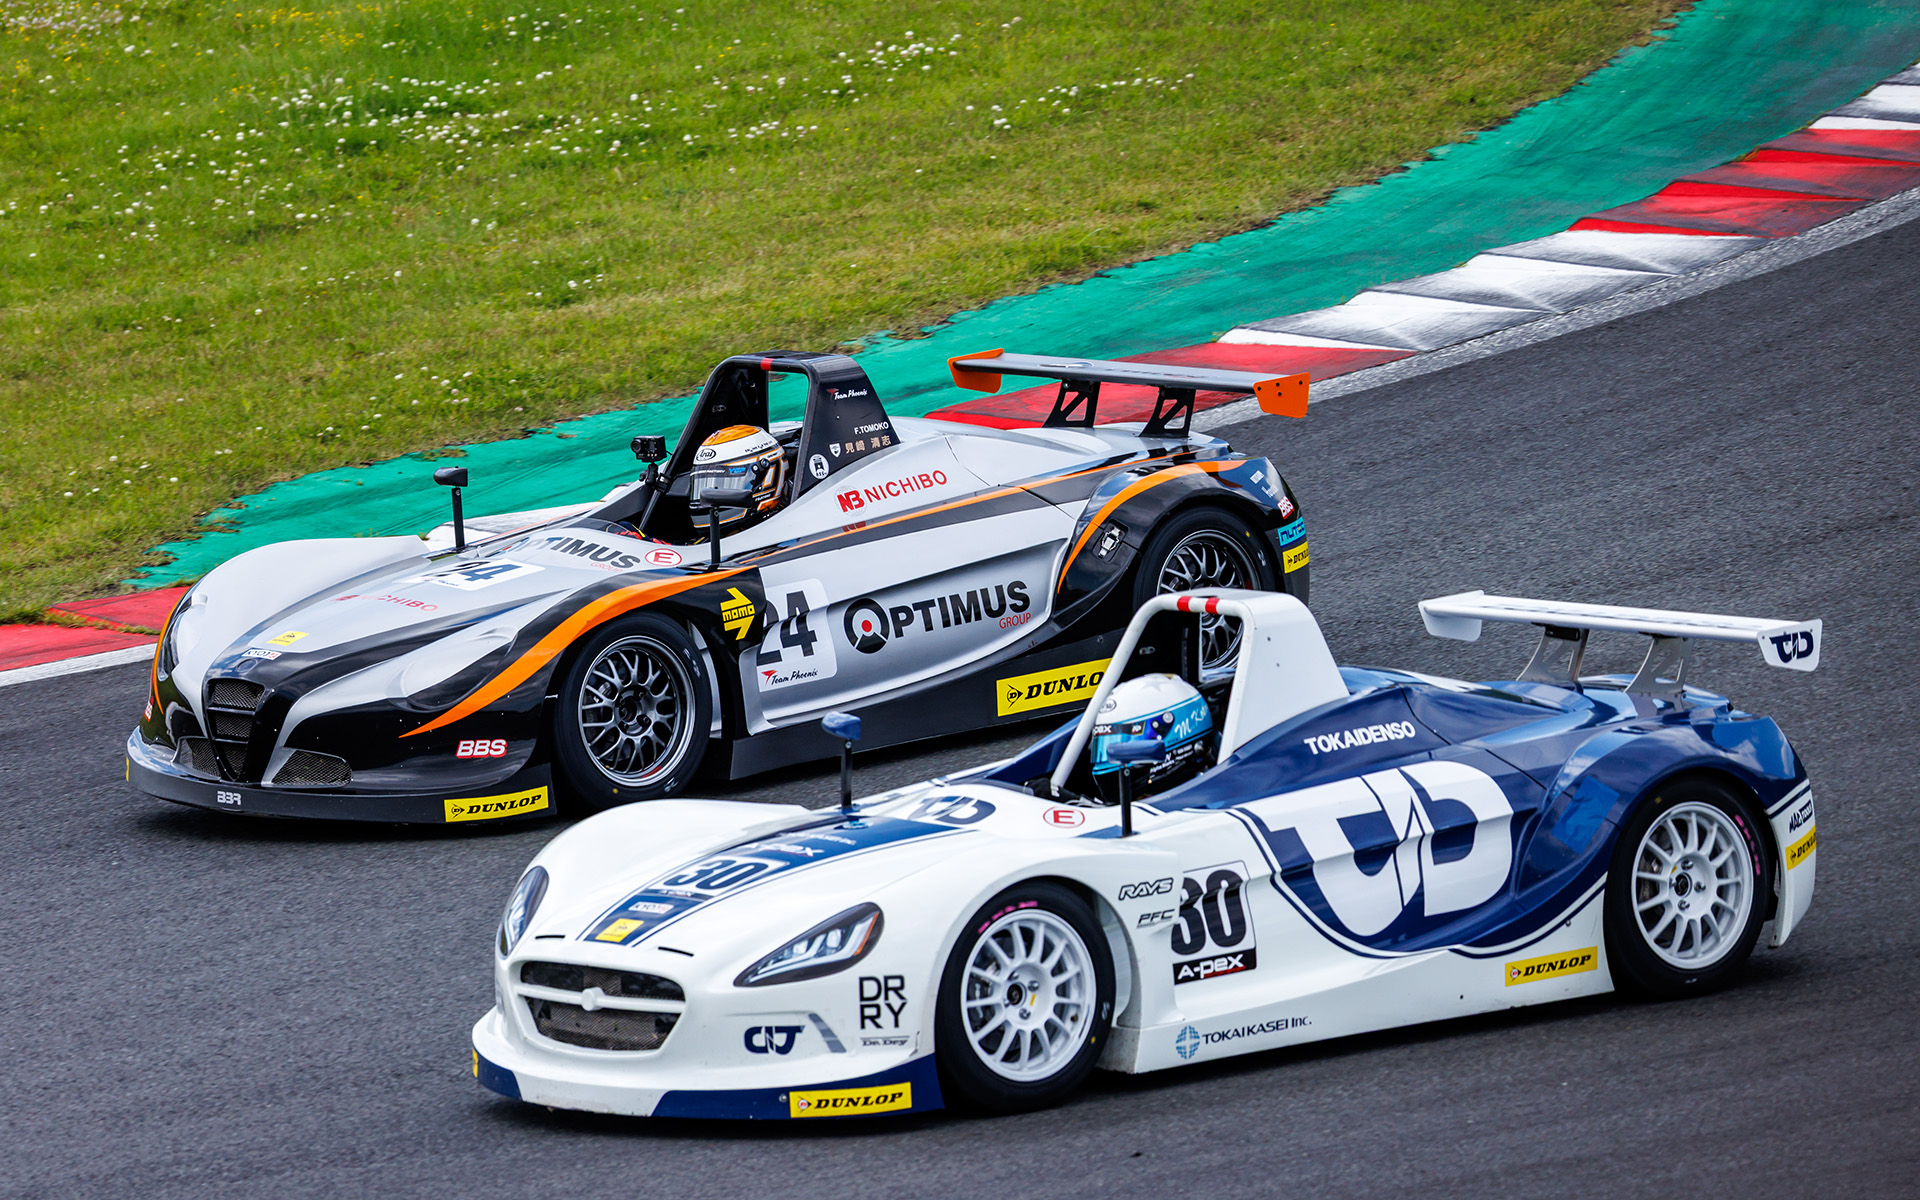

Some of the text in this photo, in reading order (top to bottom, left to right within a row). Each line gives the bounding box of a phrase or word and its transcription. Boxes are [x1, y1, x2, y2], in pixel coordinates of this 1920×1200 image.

[834, 391, 848, 400] Team
[854, 421, 889, 435] F.TOMOKO
[864, 470, 948, 504] NICHIBO
[756, 590, 818, 666] 24
[843, 580, 1031, 655] OPTIMUS
[999, 612, 1032, 629] GROUP
[771, 668, 819, 686] Team Phoenix
[1024, 671, 1107, 700] DUNLO
[456, 738, 508, 759] BBS
[1304, 720, 1416, 755] TOKAIDENSO
[466, 794, 542, 815] DUNLOP
[663, 859, 769, 889] 30
[1138, 908, 1176, 924] PFC
[1171, 869, 1247, 955] 30
[1177, 953, 1245, 980] A-pex
[1523, 953, 1592, 977] DUNLOP
[1202, 1016, 1313, 1045] TOKAI KASEI Inc.
[814, 1092, 903, 1109] DUNLOP
